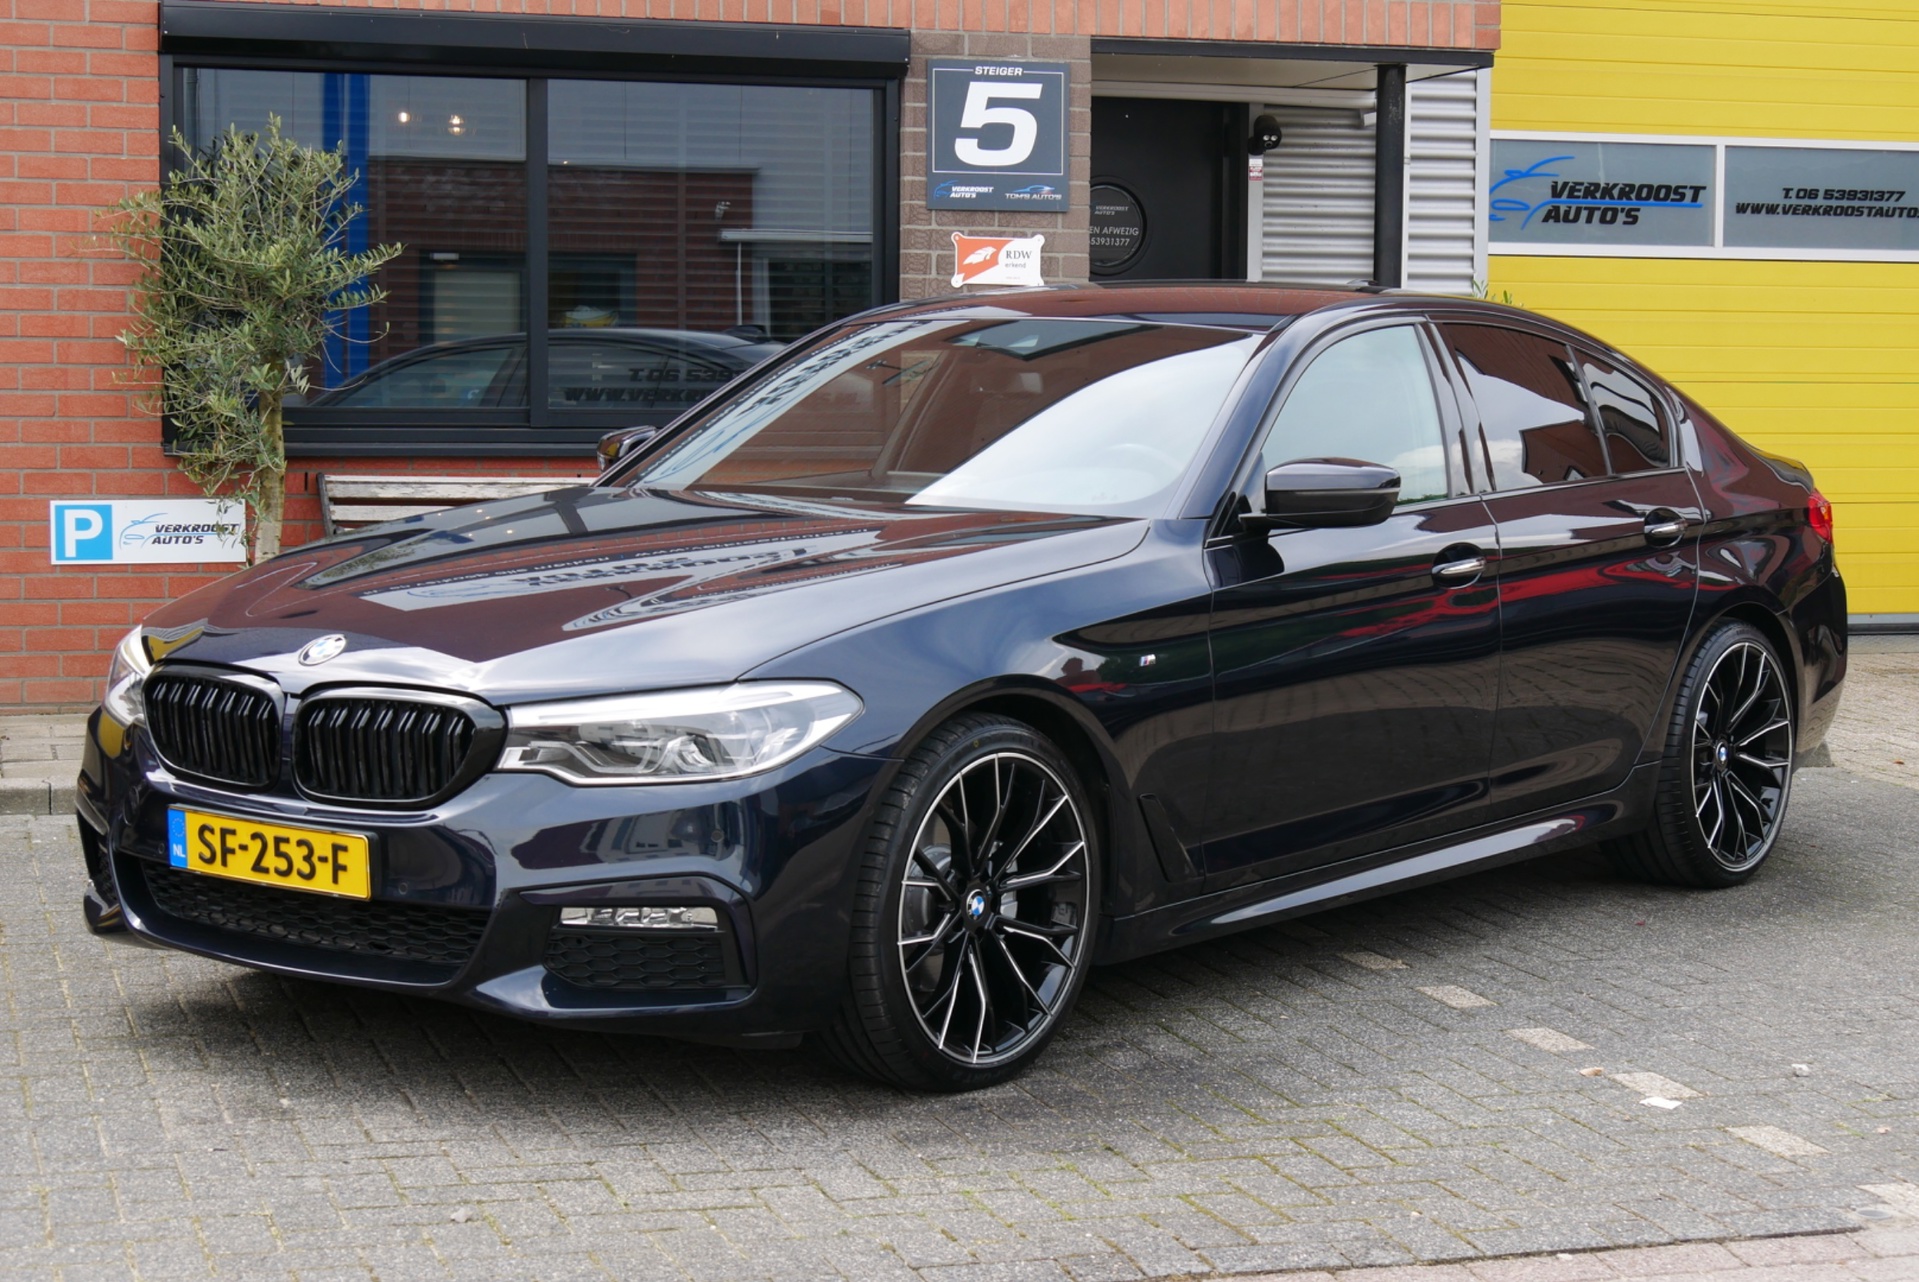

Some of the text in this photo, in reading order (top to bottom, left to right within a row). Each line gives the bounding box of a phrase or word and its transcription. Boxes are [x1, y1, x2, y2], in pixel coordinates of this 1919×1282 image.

[974, 66, 1023, 76] STEIGER
[954, 81, 1043, 166] 5
[1551, 181, 1707, 203] VERKROOST
[1823, 189, 1906, 202] 53931377
[1541, 205, 1641, 225] AUTO'S
[1735, 203, 1919, 219] WWW.VERKROOSTAUTO
[1102, 226, 1139, 235] AFWEZIG
[1006, 250, 1032, 259] RDW
[64, 509, 103, 557] P
[152, 535, 203, 544] AUTO'S
[172, 843, 186, 858] NL
[198, 823, 349, 886] SF-253-F
